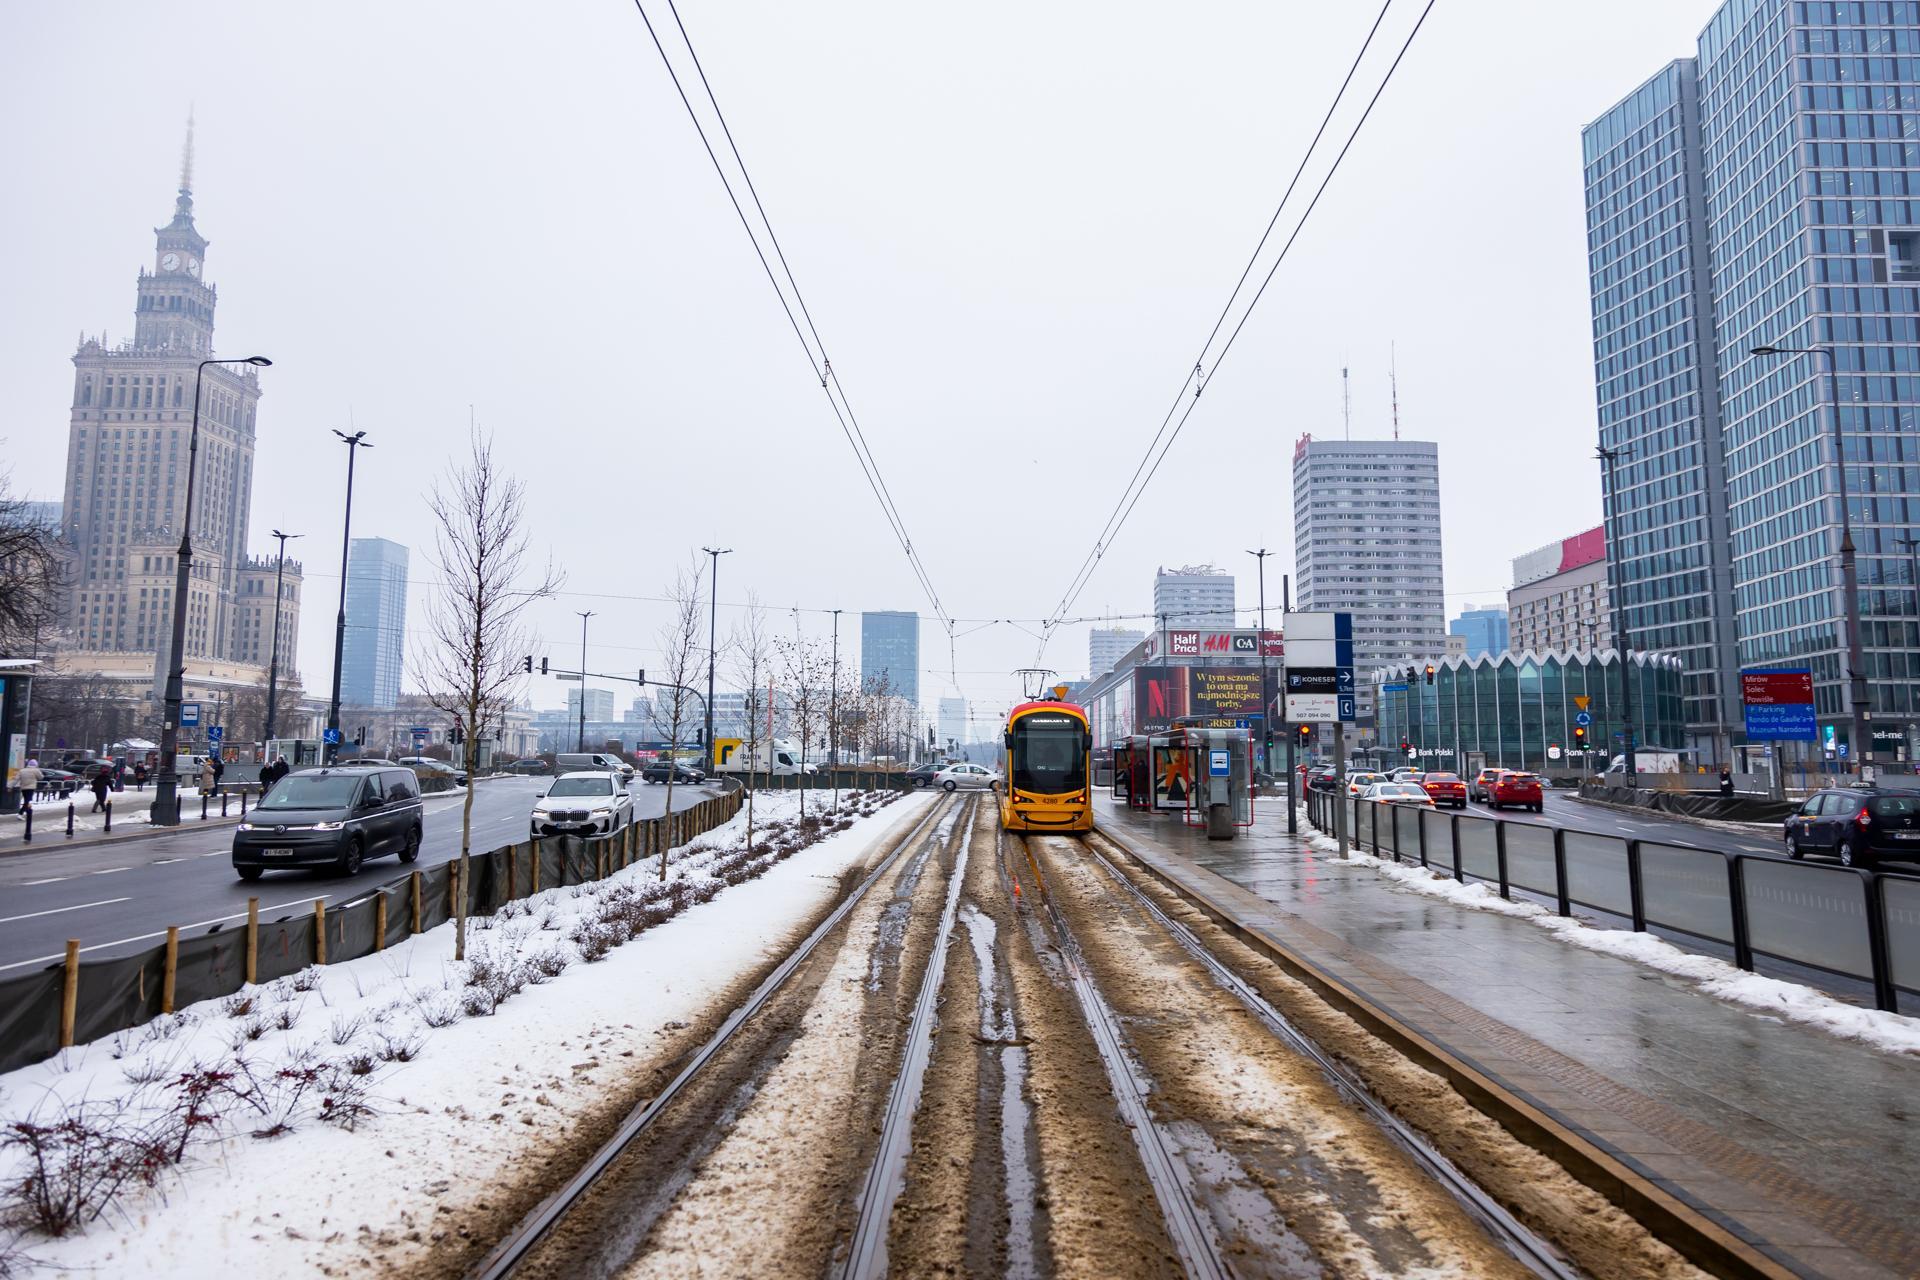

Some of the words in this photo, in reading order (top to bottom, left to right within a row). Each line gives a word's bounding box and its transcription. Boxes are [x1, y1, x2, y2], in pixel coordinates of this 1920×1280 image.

[1174, 634, 1197, 644] Half
[1174, 644, 1198, 653] Price
[1197, 673, 1206, 681] W
[1208, 673, 1225, 683] tym
[1228, 673, 1260, 681] sezonie
[1197, 692, 1260, 702] najmodniejsze
[1216, 700, 1242, 709] torby.
[1759, 706, 1785, 714] Parking
[1564, 748, 1583, 757] Bank
